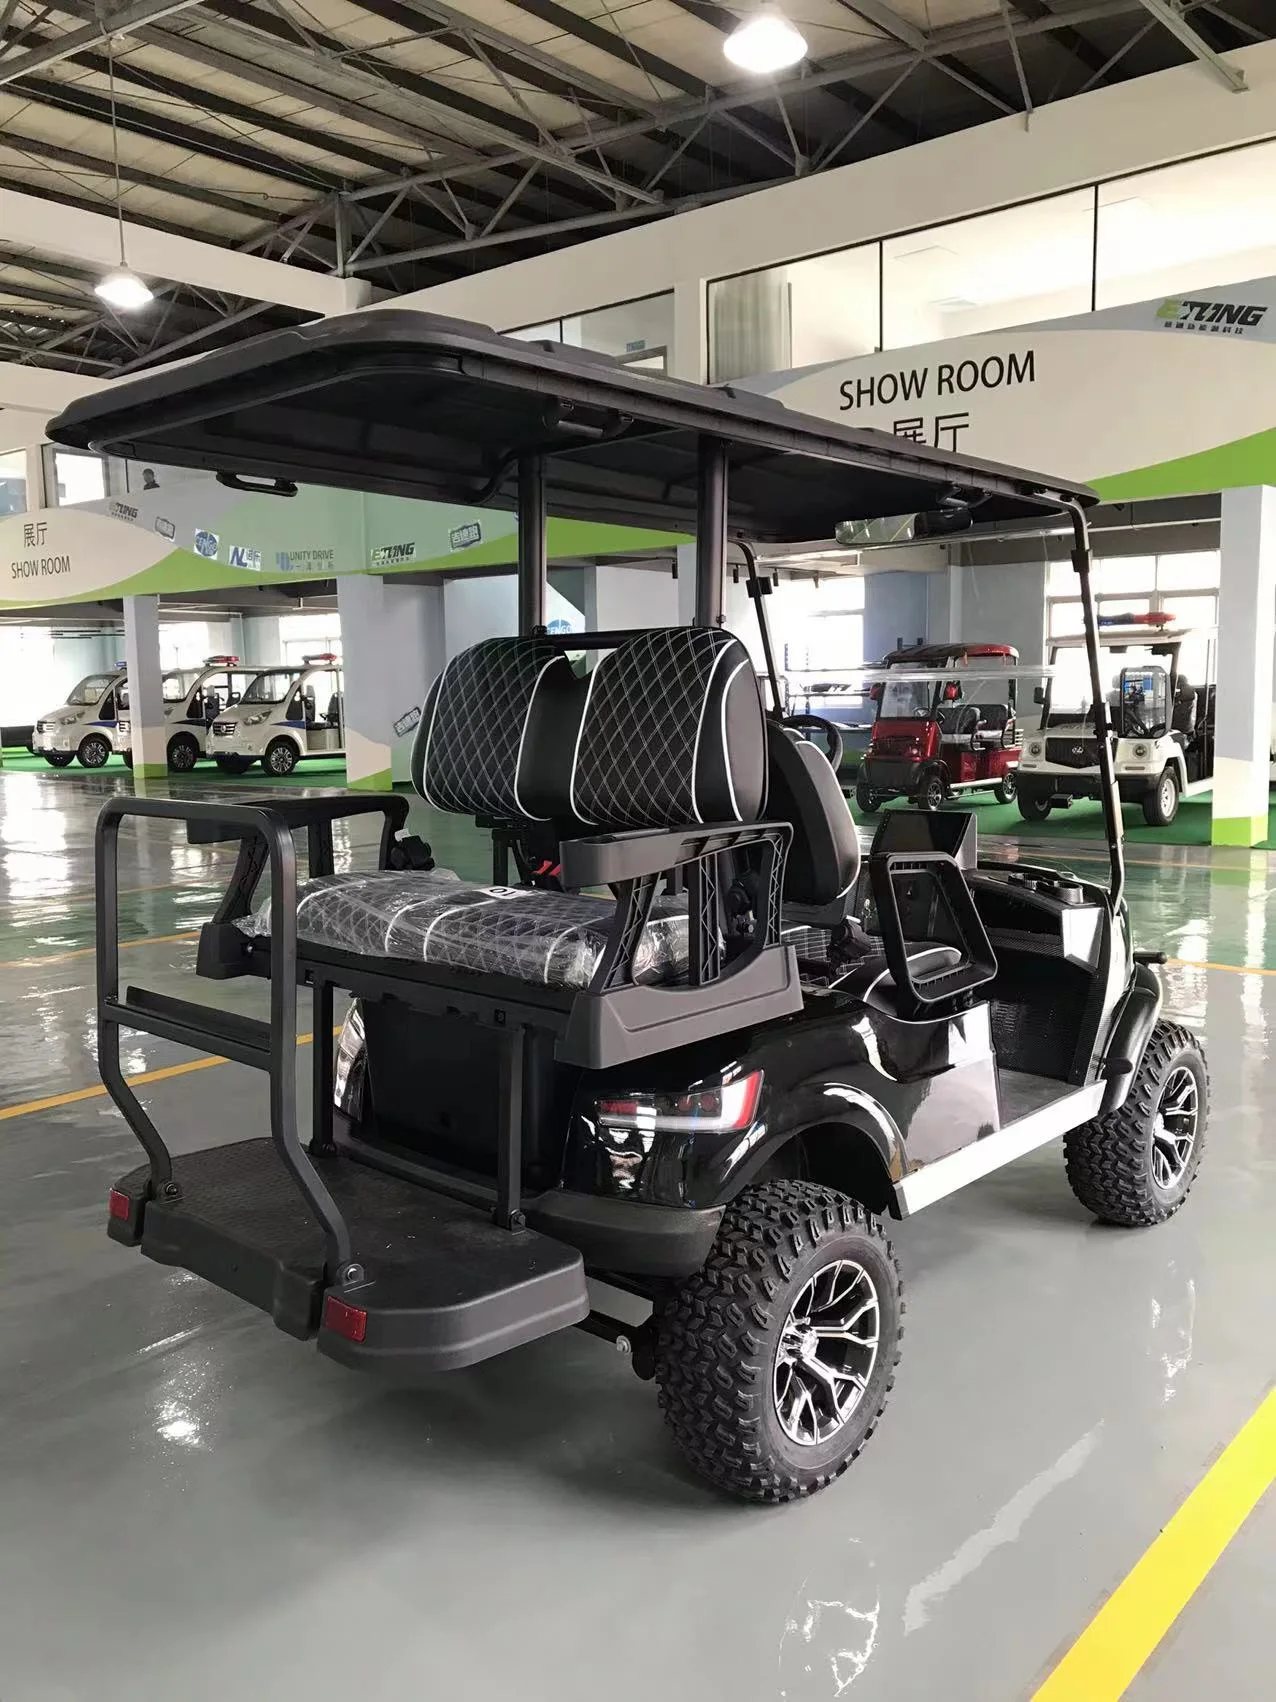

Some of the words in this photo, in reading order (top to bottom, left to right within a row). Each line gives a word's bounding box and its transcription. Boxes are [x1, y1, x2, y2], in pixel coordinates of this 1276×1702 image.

[839, 367, 928, 411] SHOW
[937, 350, 1035, 396] ROOM
[23, 522, 47, 548] 展厅
[11, 560, 39, 579] SHOW
[41, 555, 71, 575] ROOM
[290, 550, 311, 561] UNITY
[312, 549, 335, 560] DRIVE
